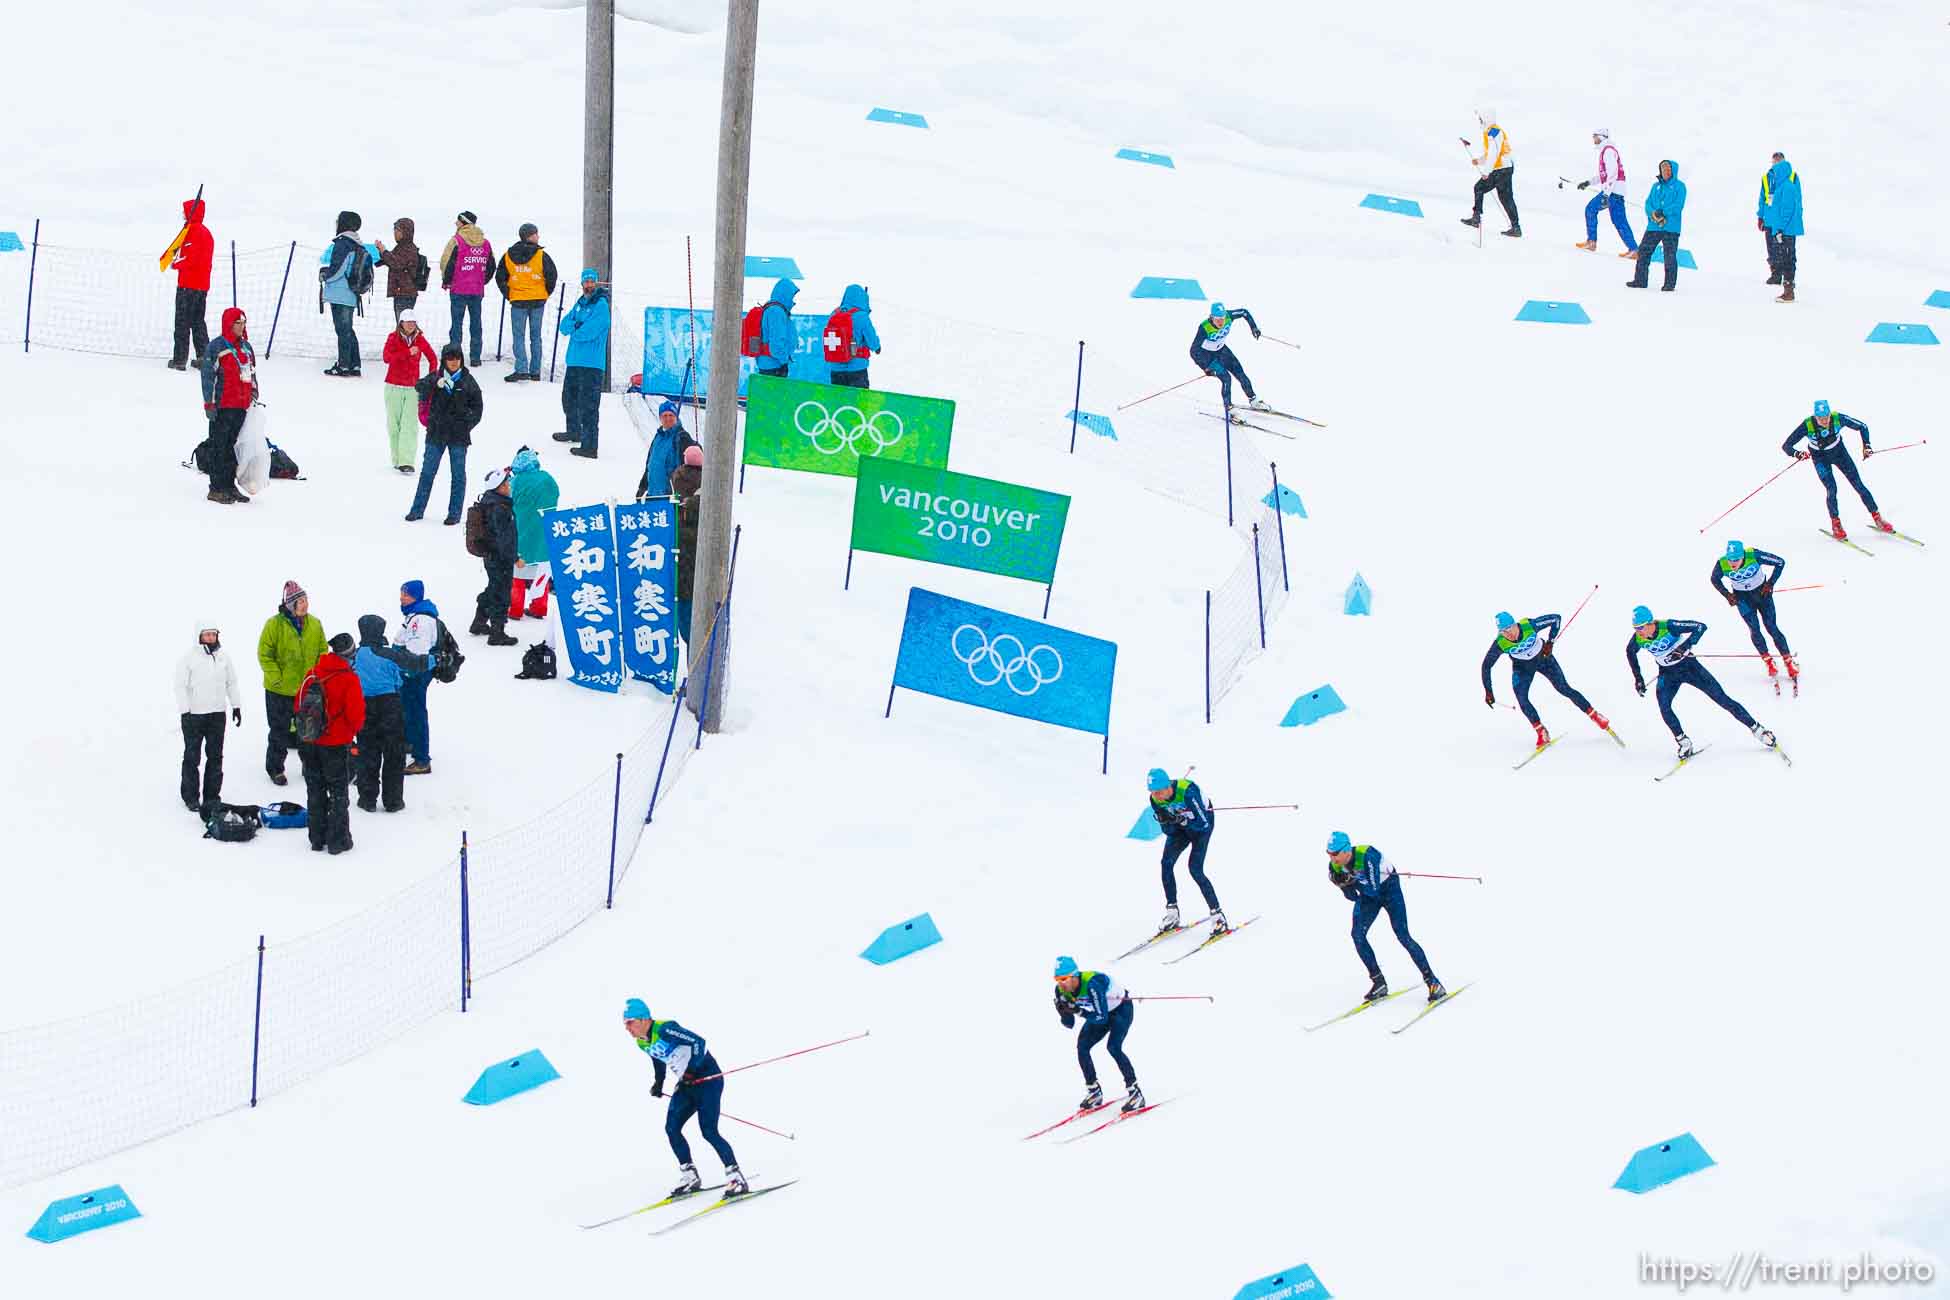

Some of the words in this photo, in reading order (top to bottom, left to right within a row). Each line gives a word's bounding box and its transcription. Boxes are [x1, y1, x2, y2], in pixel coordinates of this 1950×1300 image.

[552, 514, 608, 538] 北海道
[620, 510, 669, 531] 北海道
[880, 484, 1040, 531] vancouver
[917, 516, 991, 547] 2010
[561, 539, 614, 665] 和寒町
[627, 533, 671, 665] 和寒町
